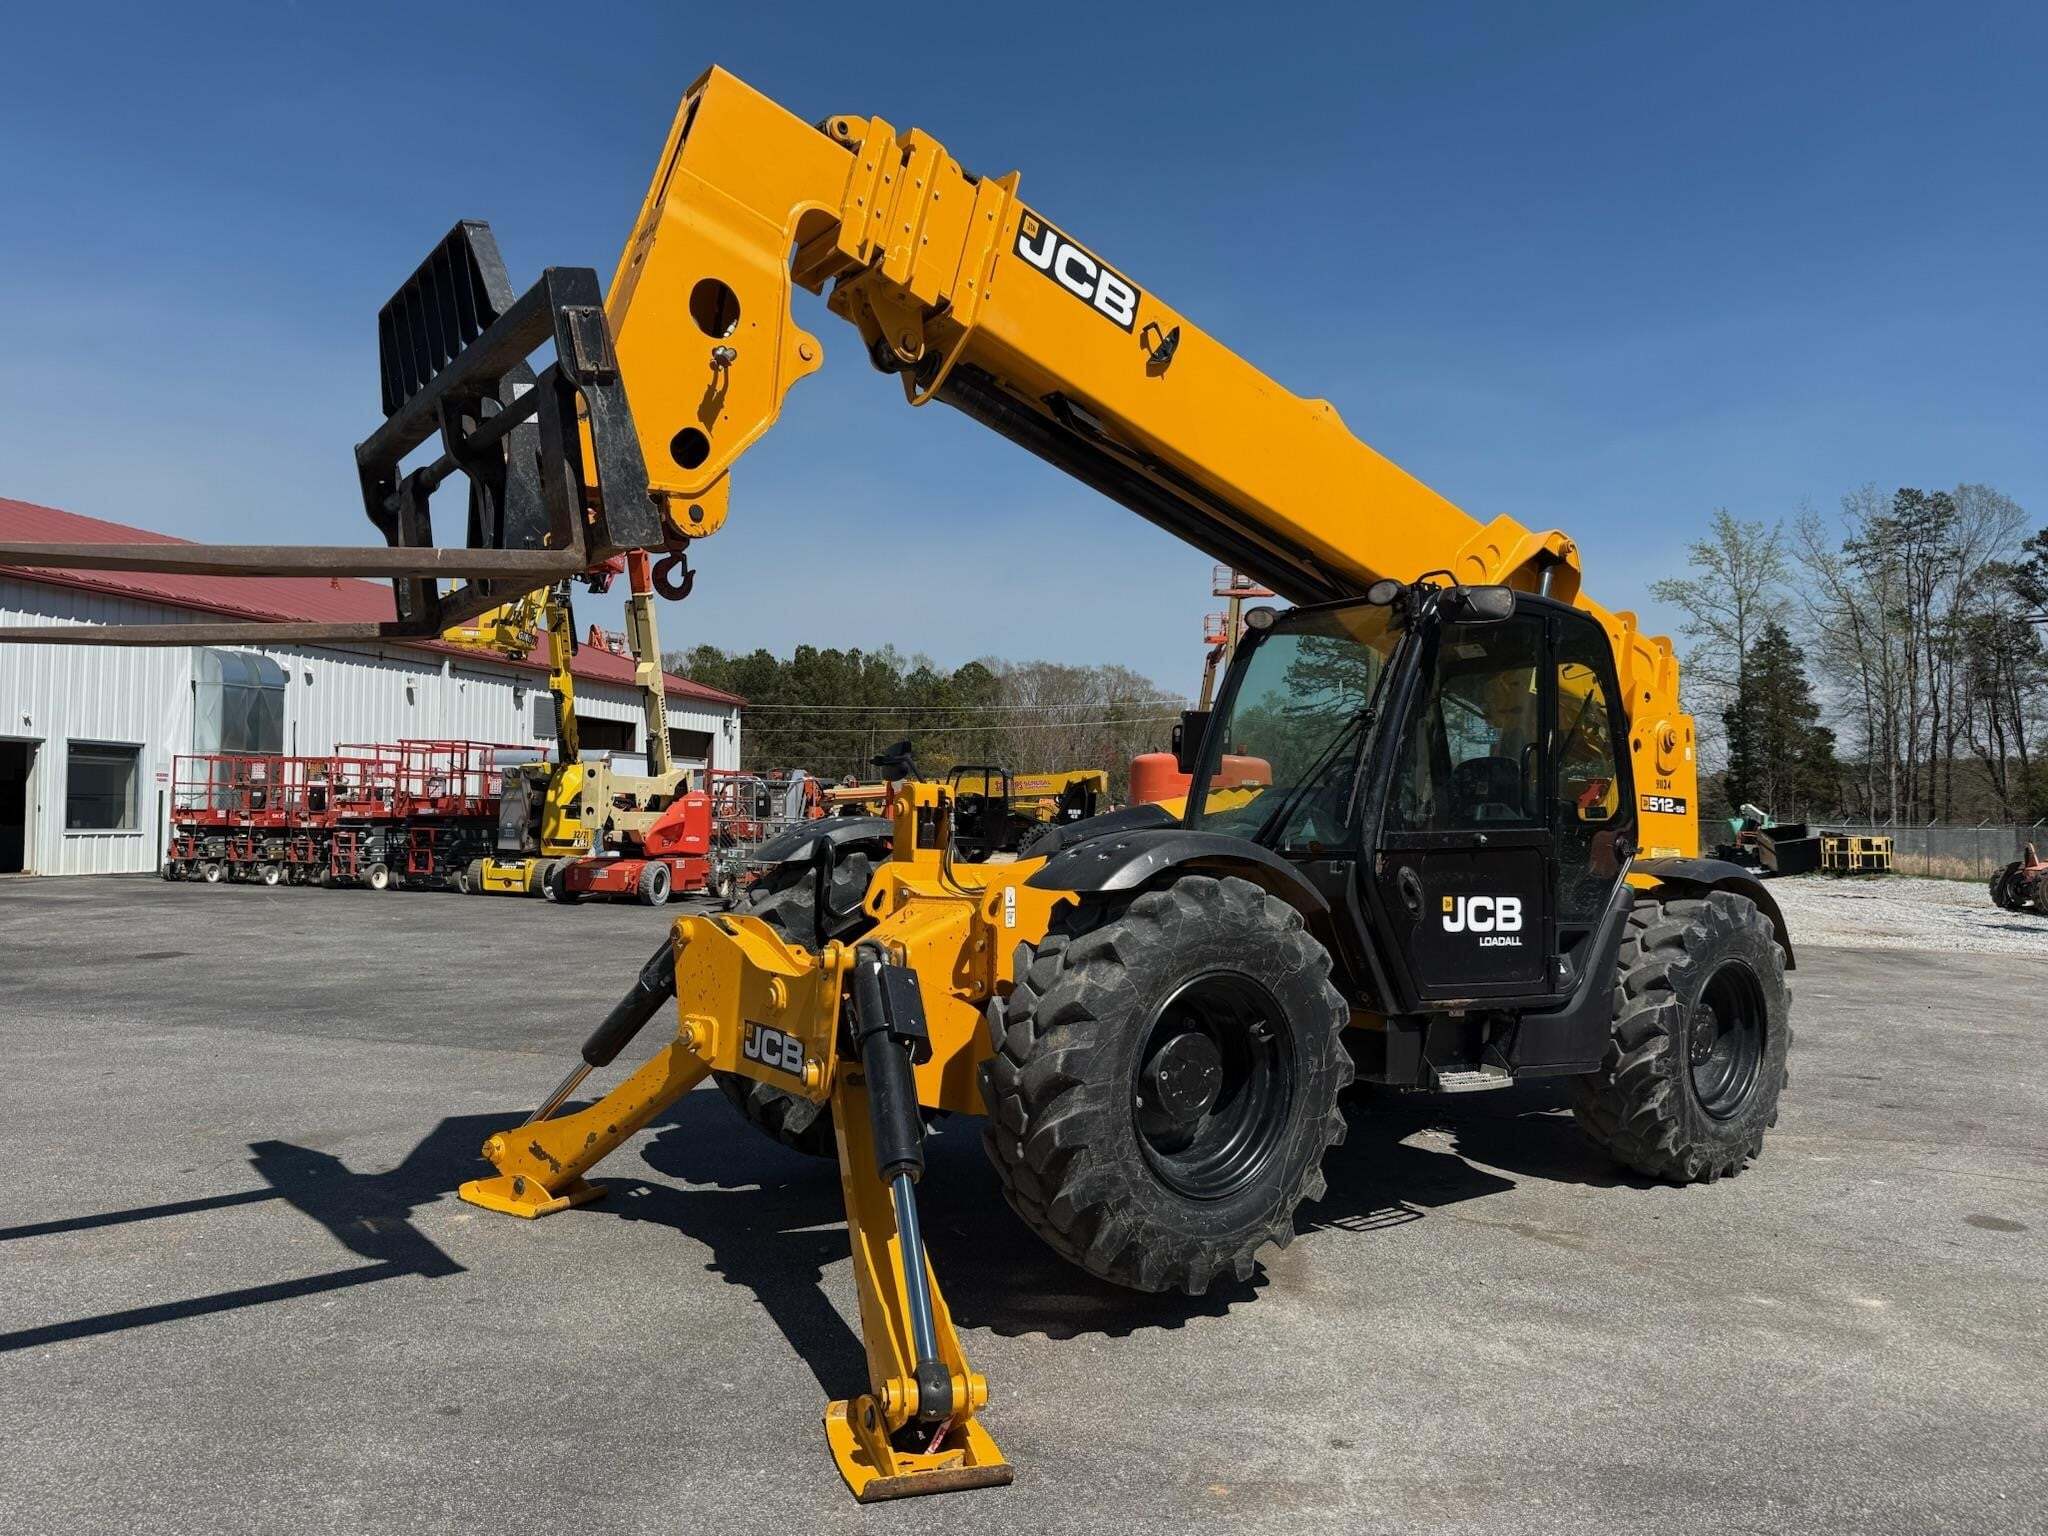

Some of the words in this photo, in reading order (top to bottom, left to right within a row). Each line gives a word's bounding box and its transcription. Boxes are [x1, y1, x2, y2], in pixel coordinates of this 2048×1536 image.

[1018, 229, 1136, 327] JCB
[1649, 797, 1685, 813] 512-56
[1442, 896, 1522, 932] JCB
[1479, 936, 1522, 946] LOADALL
[745, 1026, 803, 1073] JCB
